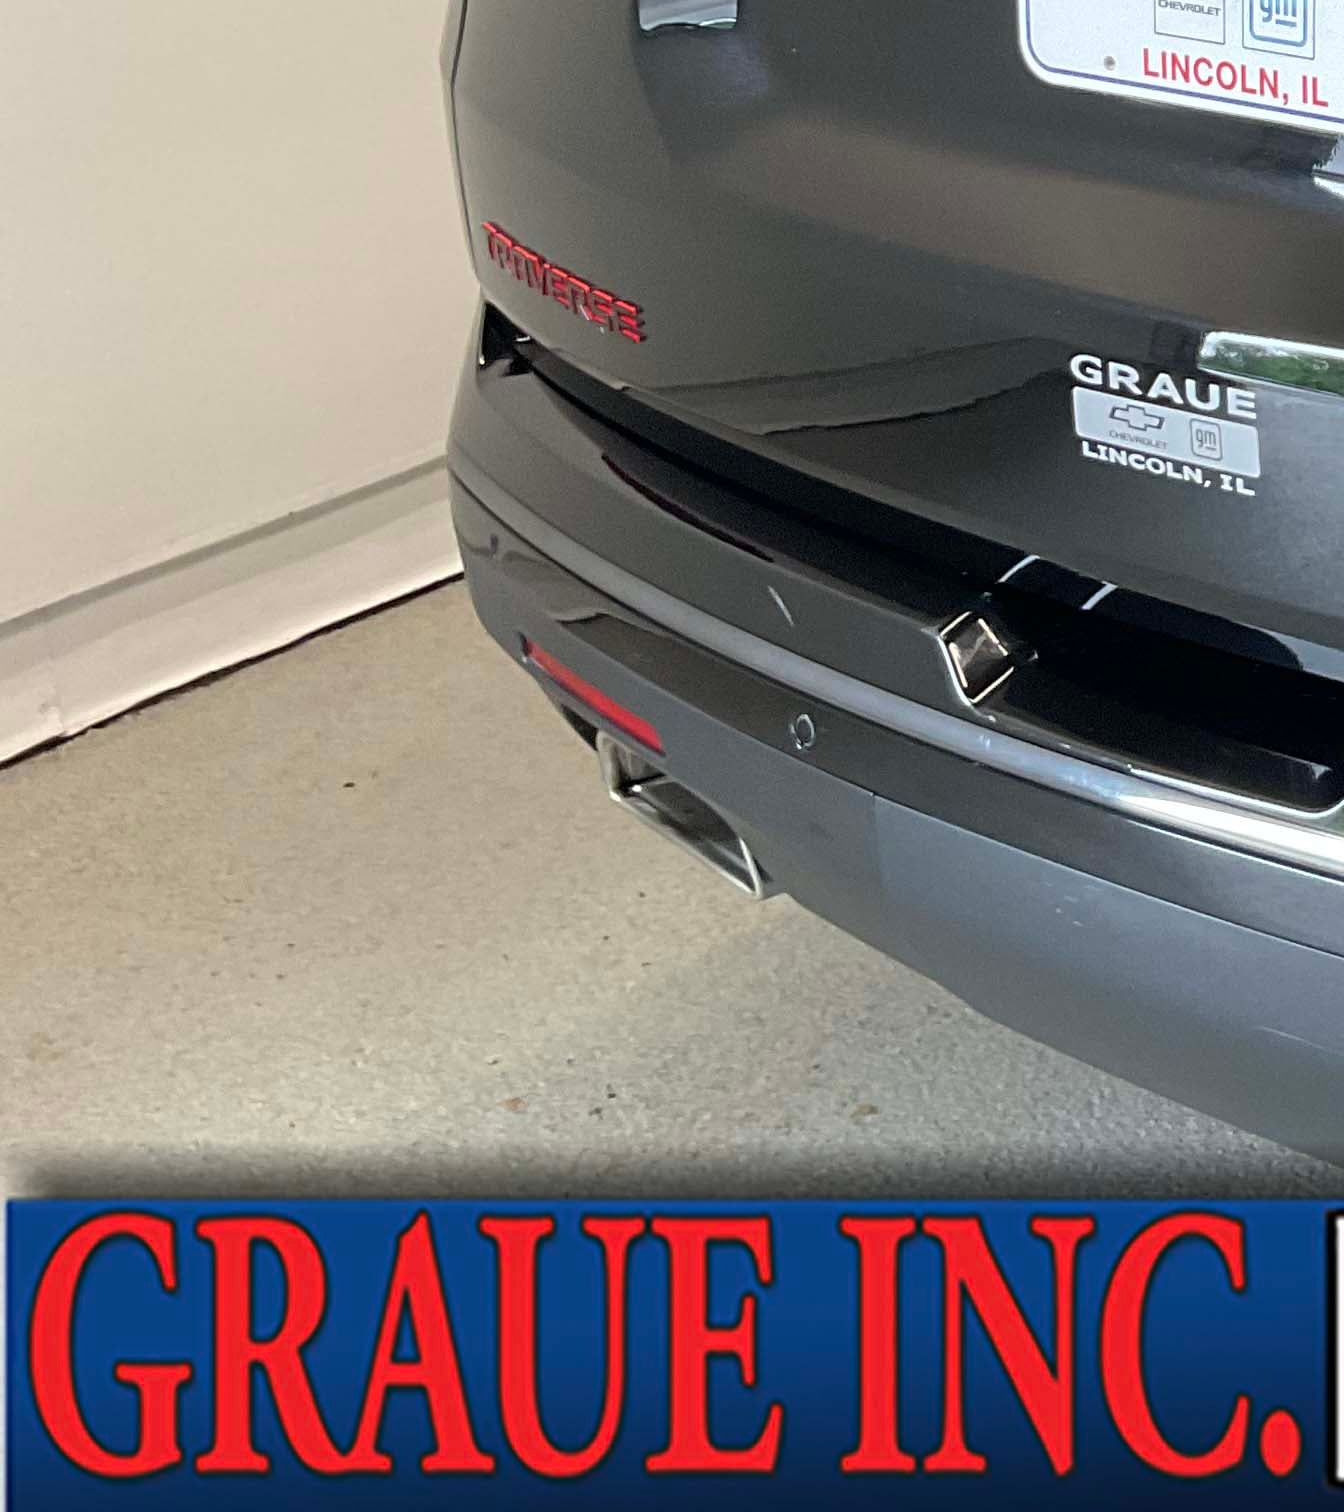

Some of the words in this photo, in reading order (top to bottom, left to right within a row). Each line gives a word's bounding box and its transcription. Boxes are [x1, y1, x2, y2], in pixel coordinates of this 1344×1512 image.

[1142, 47, 1290, 106] LINCOLN,
[1301, 75, 1329, 107] IL
[1070, 354, 1257, 419] GRAUE
[1108, 430, 1168, 450] CHEVROLET
[1195, 428, 1217, 451] gm
[1081, 440, 1212, 488] LINCOLN,
[1220, 474, 1256, 497] IL
